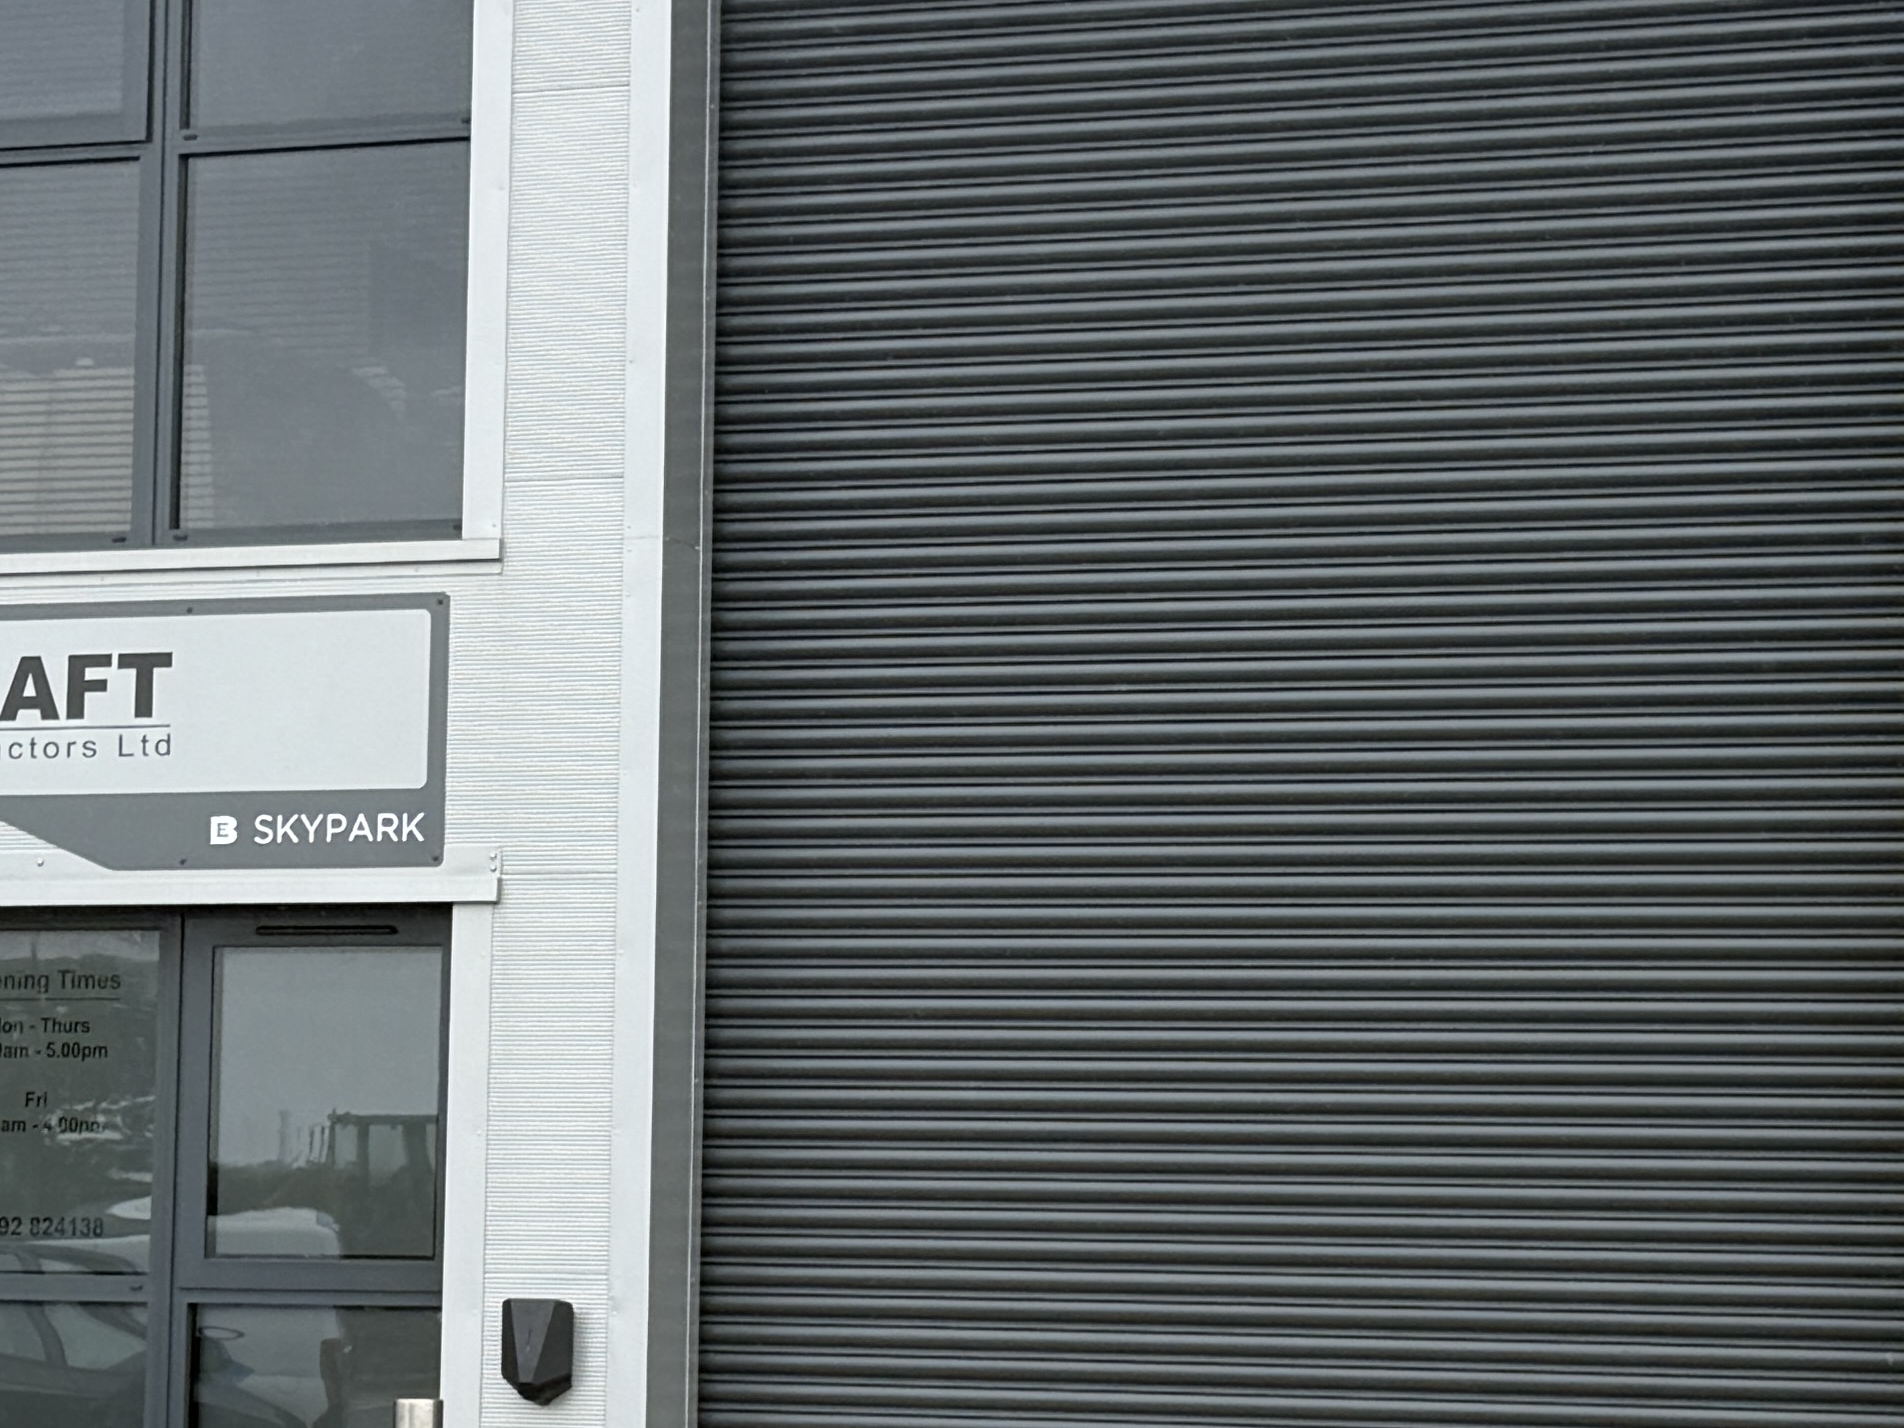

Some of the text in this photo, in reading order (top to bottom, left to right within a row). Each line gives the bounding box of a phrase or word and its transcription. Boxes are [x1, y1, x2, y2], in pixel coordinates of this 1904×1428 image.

[117, 731, 173, 759] Ltd
[254, 812, 425, 845] SKYPARK
[58, 968, 121, 990] Times
[41, 1017, 90, 1033] Thurs
[46, 1042, 108, 1062] 5.00pm
[24, 1091, 48, 1108] Fri
